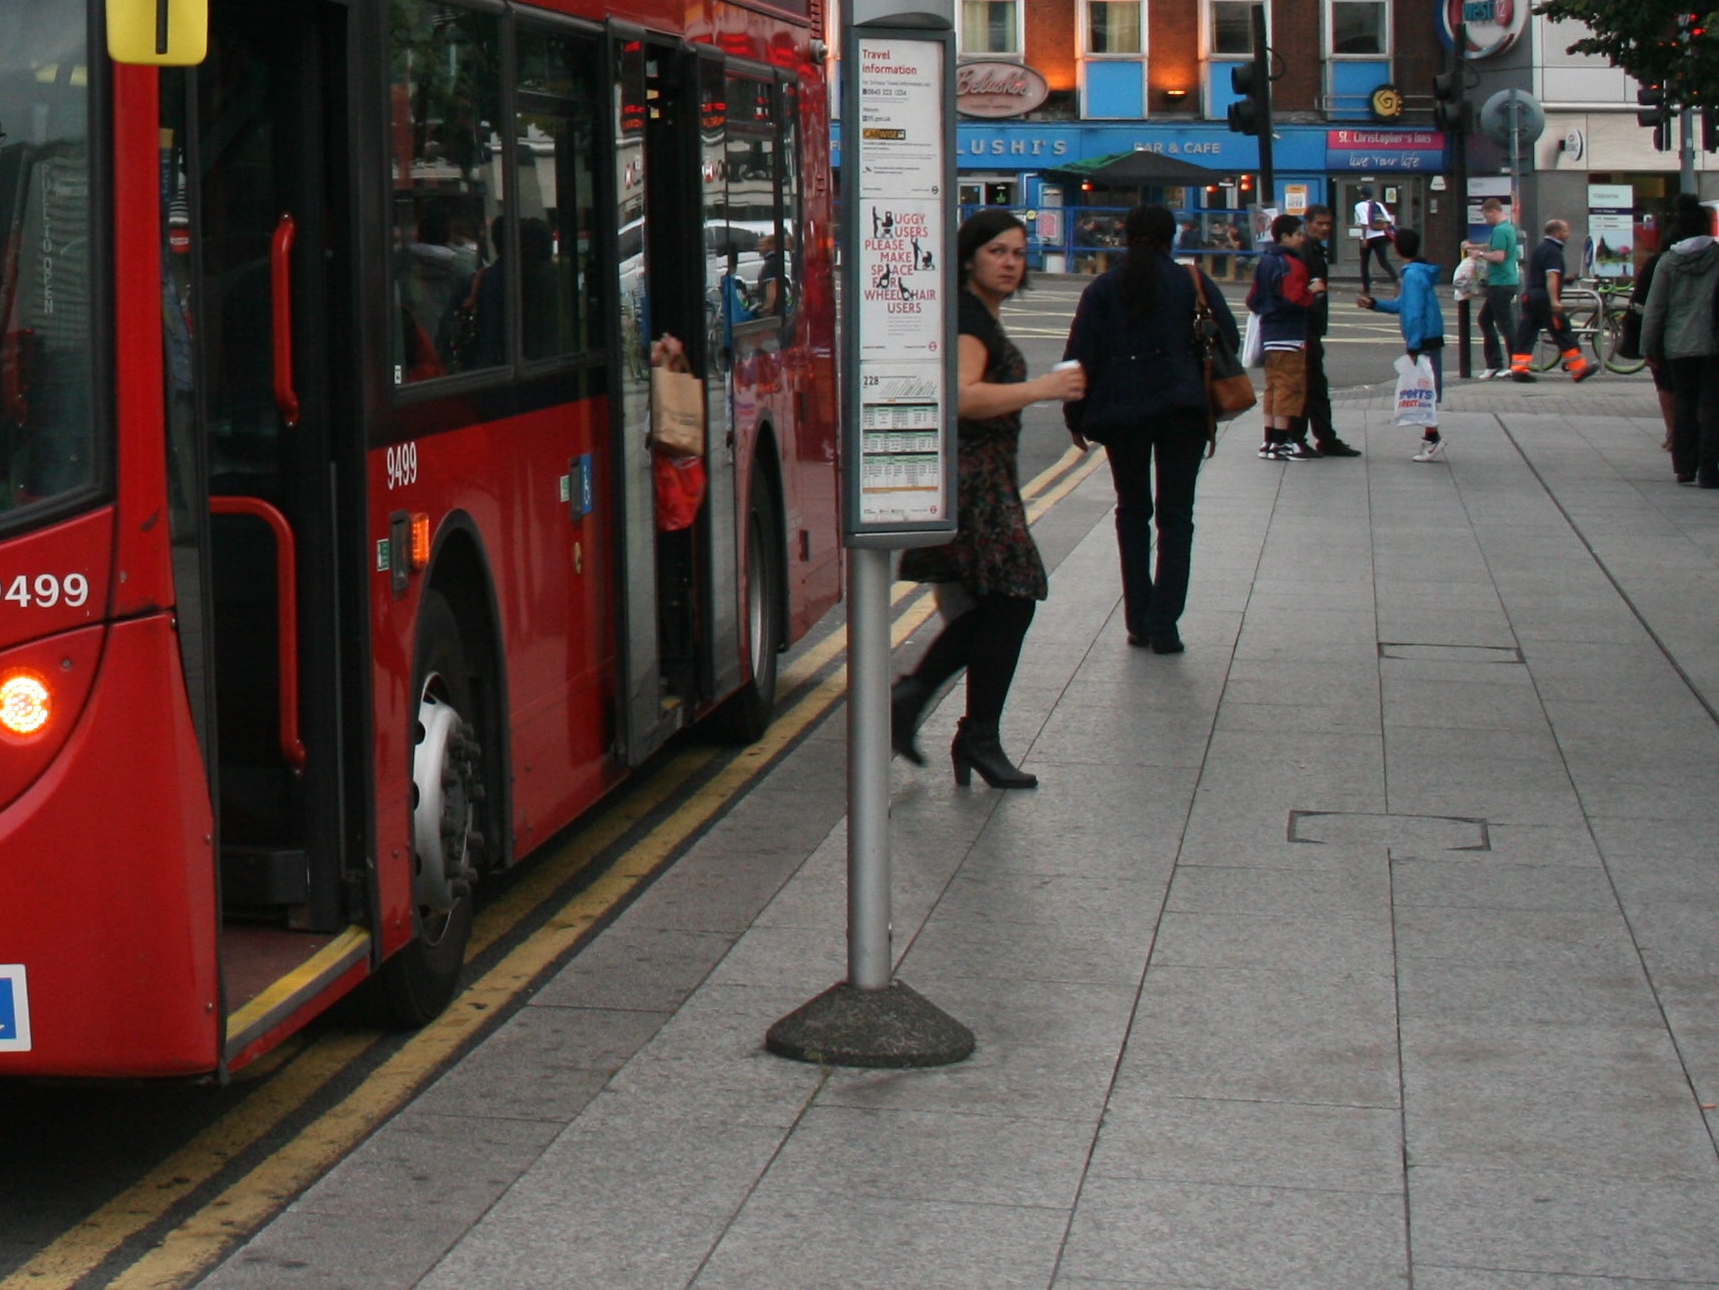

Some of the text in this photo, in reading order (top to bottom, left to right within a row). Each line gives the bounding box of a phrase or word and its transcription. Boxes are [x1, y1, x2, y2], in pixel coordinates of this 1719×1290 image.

[862, 48, 891, 60] Travel
[862, 63, 918, 75] information
[1168, 142, 1179, 154] &
[1183, 142, 1221, 154] CAFE
[894, 226, 929, 238] USERS
[864, 239, 905, 251] PLEASE
[880, 252, 912, 263] MAKE
[887, 302, 922, 314] USERS
[863, 375, 879, 386] 228
[386, 441, 417, 491] 9499
